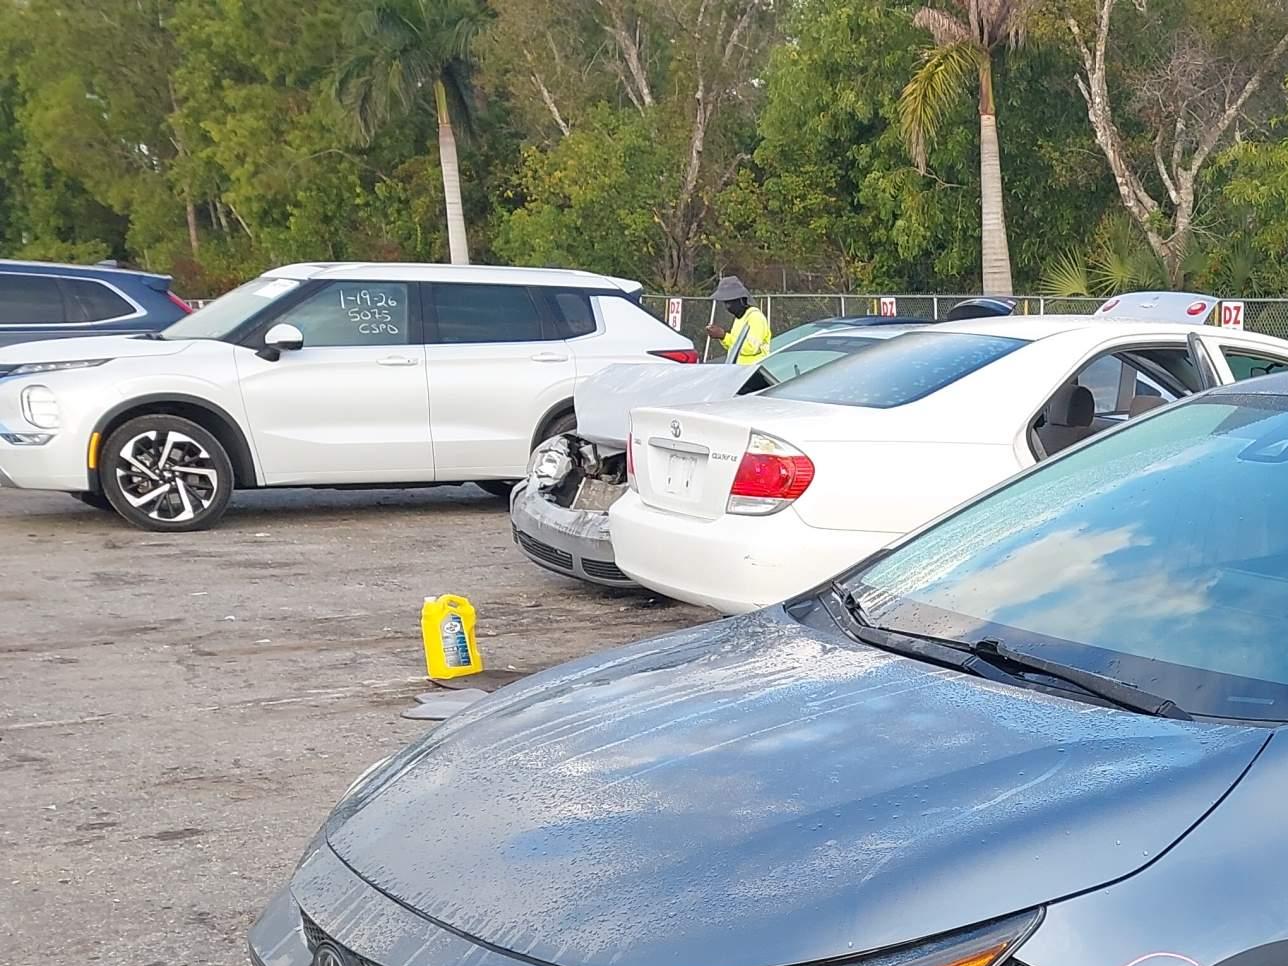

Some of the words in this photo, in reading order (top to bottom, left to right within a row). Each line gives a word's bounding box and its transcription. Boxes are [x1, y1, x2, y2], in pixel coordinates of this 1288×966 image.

[340, 290, 397, 309] 1-19-26
[670, 301, 681, 314] DZ
[882, 301, 895, 318] DZ
[1223, 305, 1242, 325] DZ
